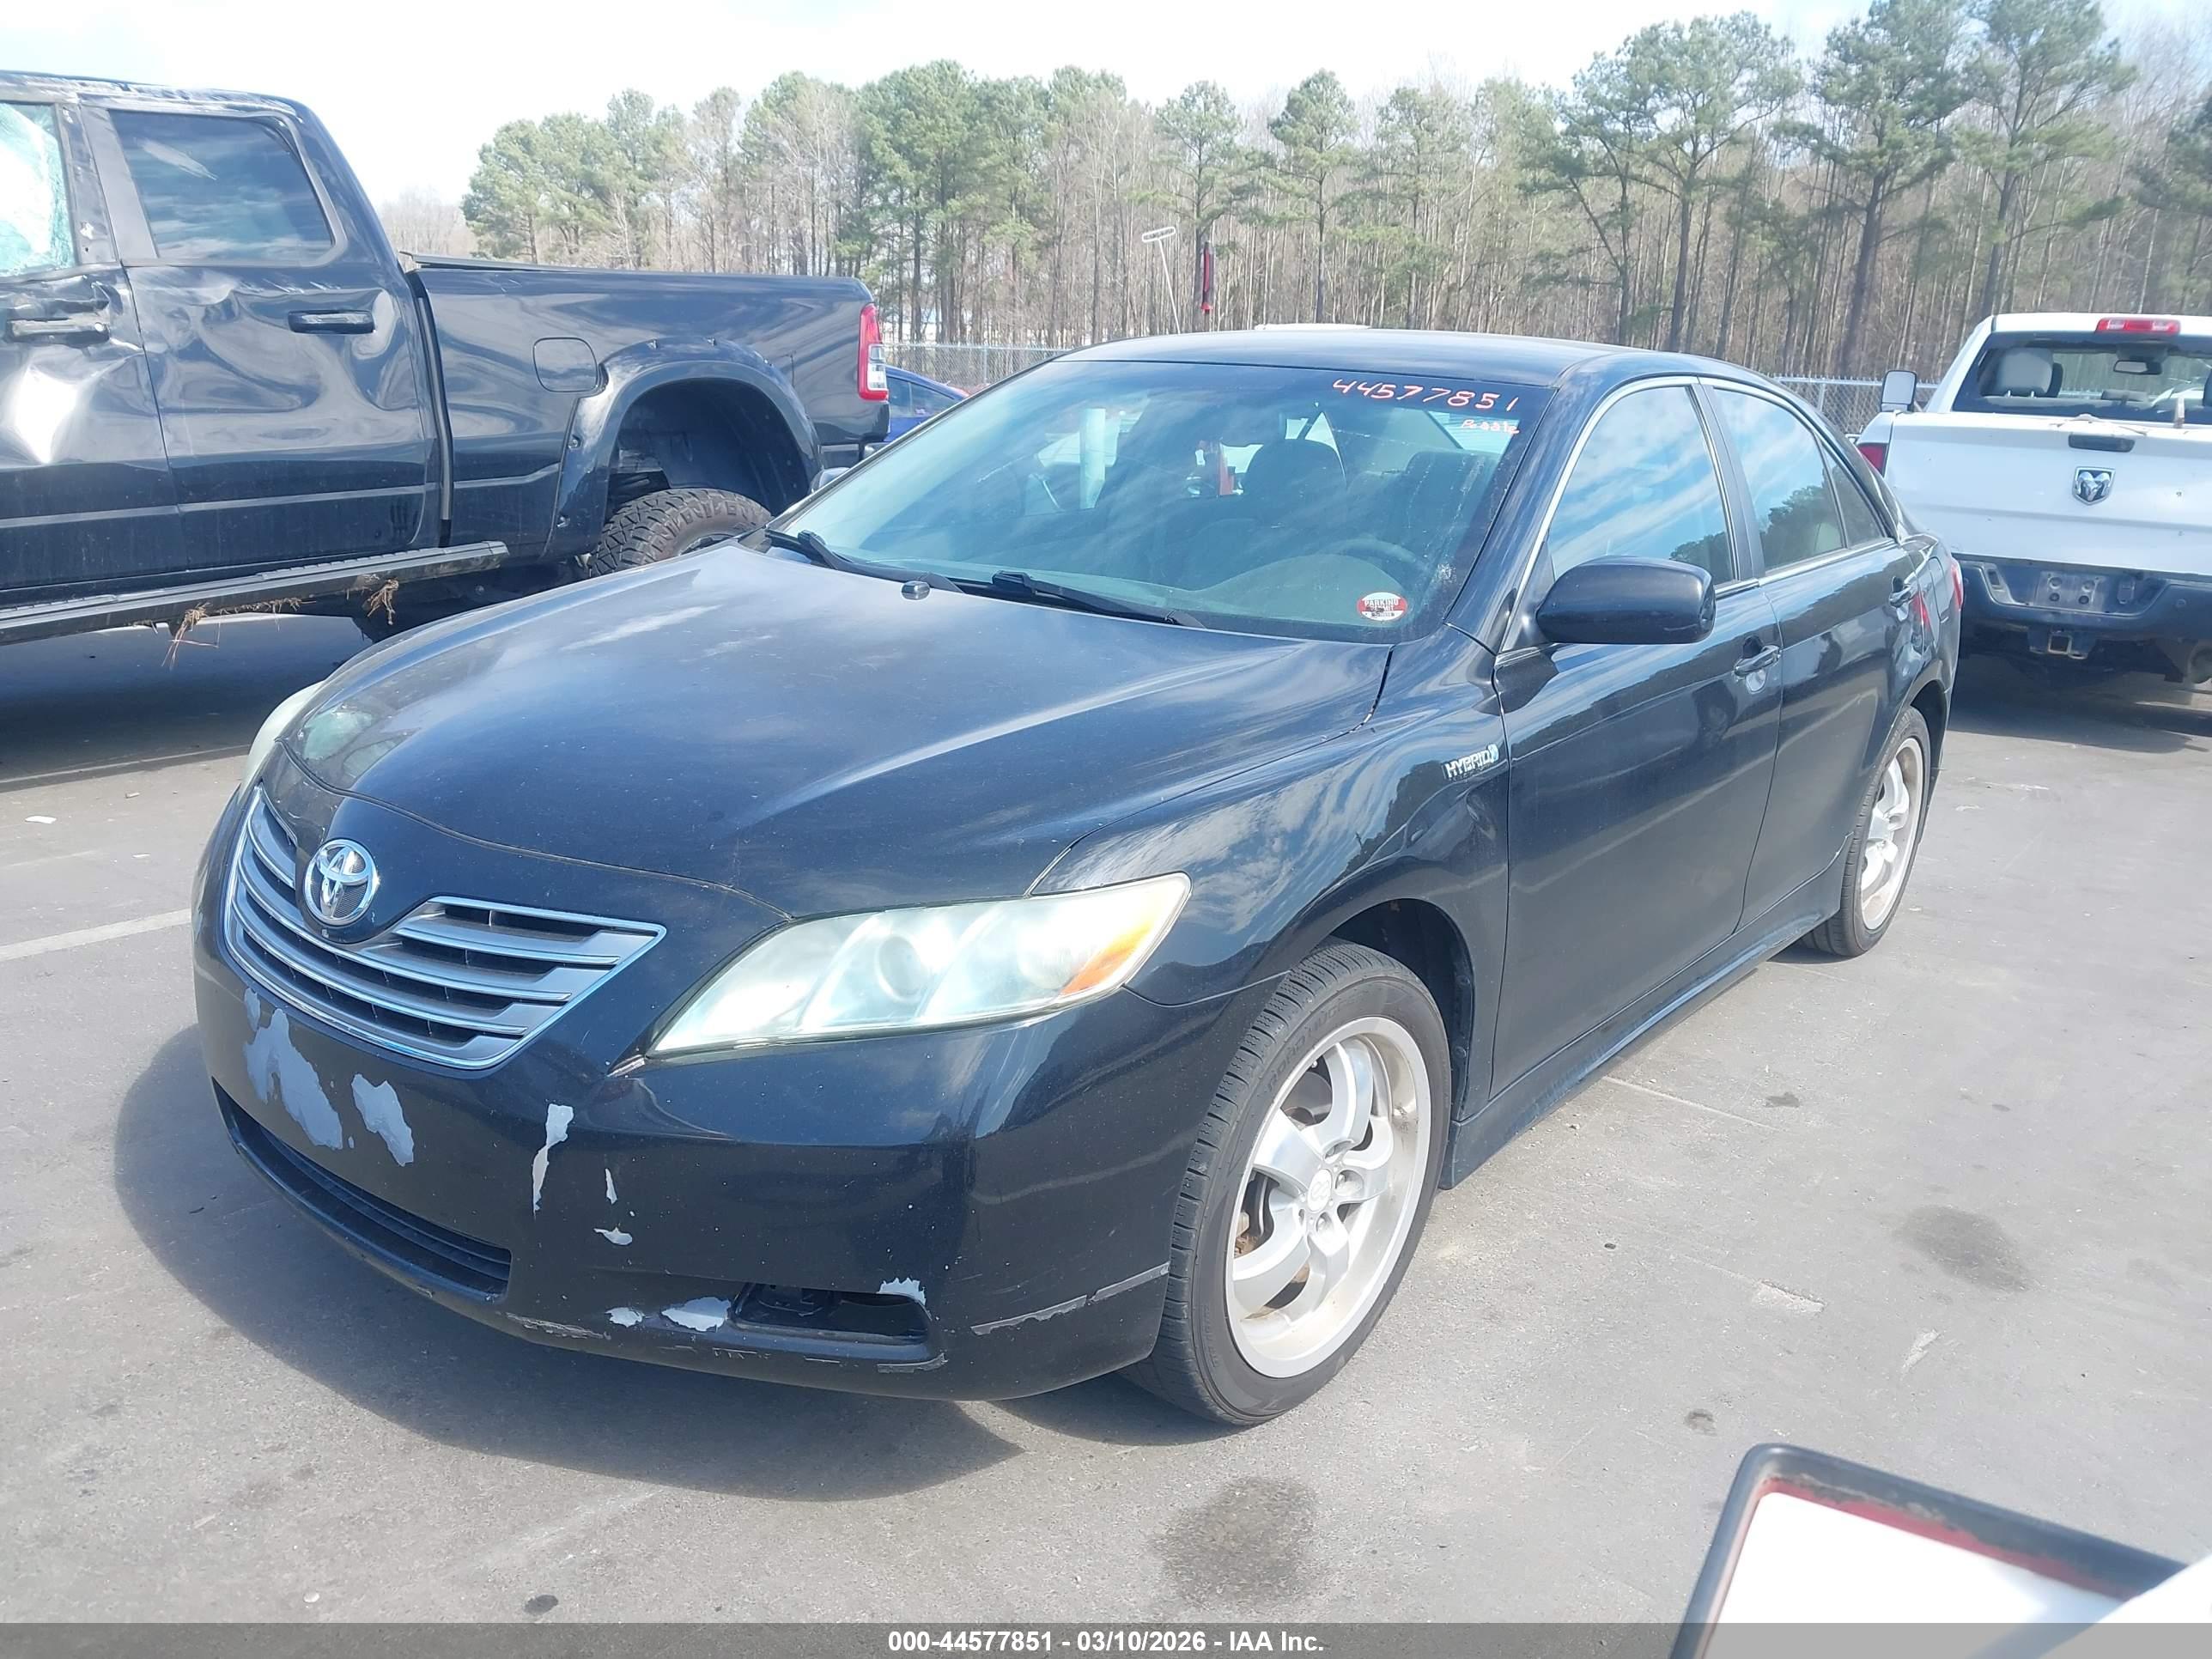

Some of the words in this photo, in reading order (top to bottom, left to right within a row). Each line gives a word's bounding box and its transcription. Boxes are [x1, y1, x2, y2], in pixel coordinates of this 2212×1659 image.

[1333, 379, 1519, 411] 44577851
[1364, 598, 1399, 606] PARKING
[1444, 749, 1492, 778] HYBRID
